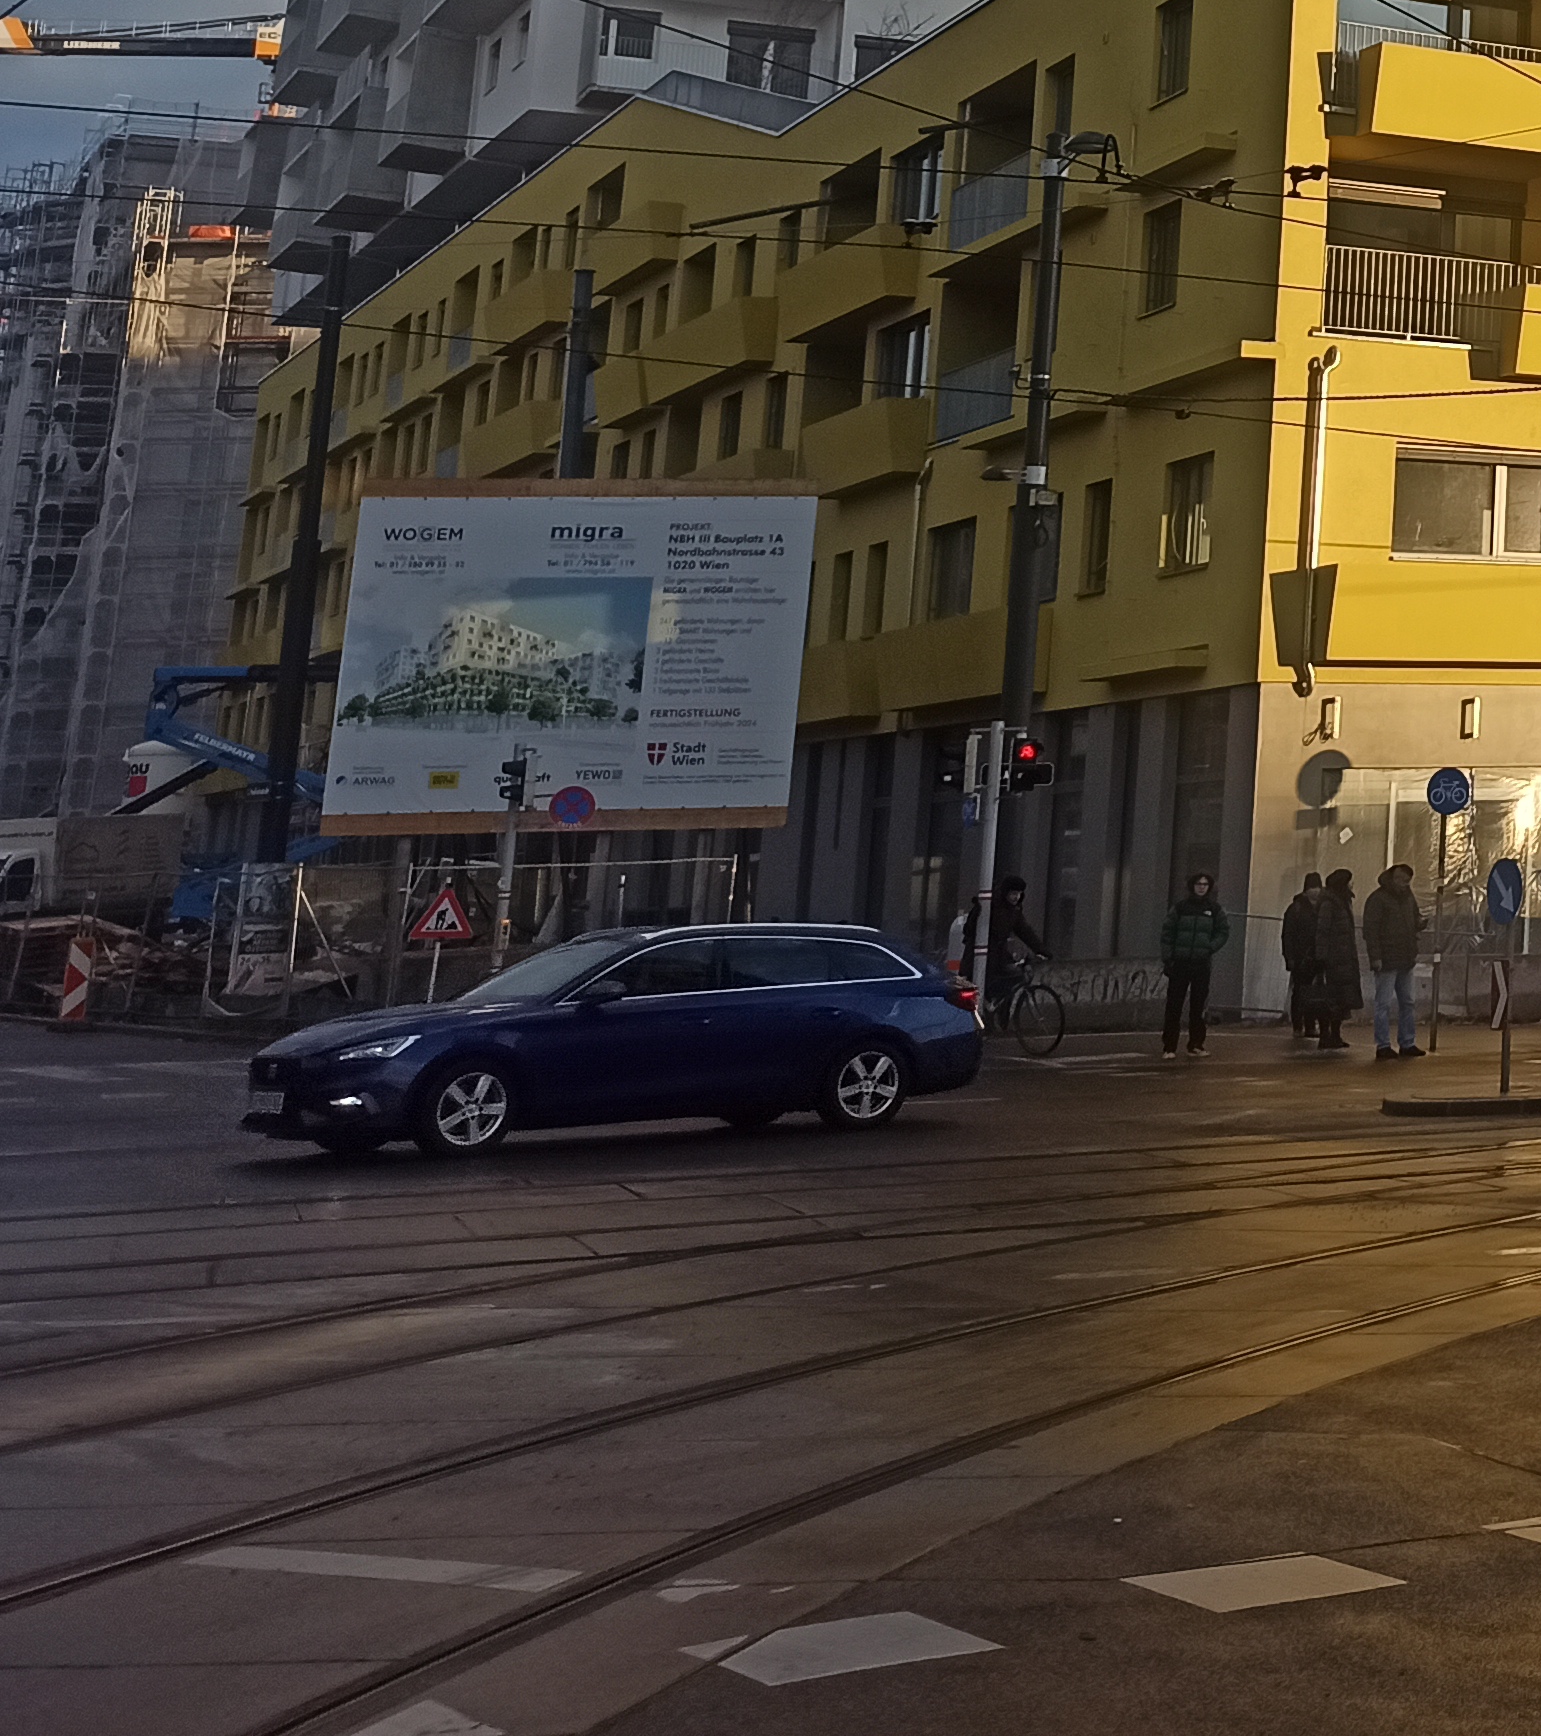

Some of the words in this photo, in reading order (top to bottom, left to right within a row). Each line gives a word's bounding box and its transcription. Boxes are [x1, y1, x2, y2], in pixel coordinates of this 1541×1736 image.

[383, 526, 464, 542] WOGEM
[550, 523, 624, 542] migra
[668, 534, 696, 544] NBH
[714, 534, 764, 546] Bauplatz
[769, 534, 784, 543] 1A
[667, 547, 766, 557] Nordbahnstrasse
[769, 547, 785, 556] 43
[667, 560, 696, 570] 1020
[699, 560, 730, 570] Wien
[649, 708, 742, 719] FERTIGSTELLUNG
[672, 742, 707, 753] Stadt
[671, 755, 706, 766] Wien
